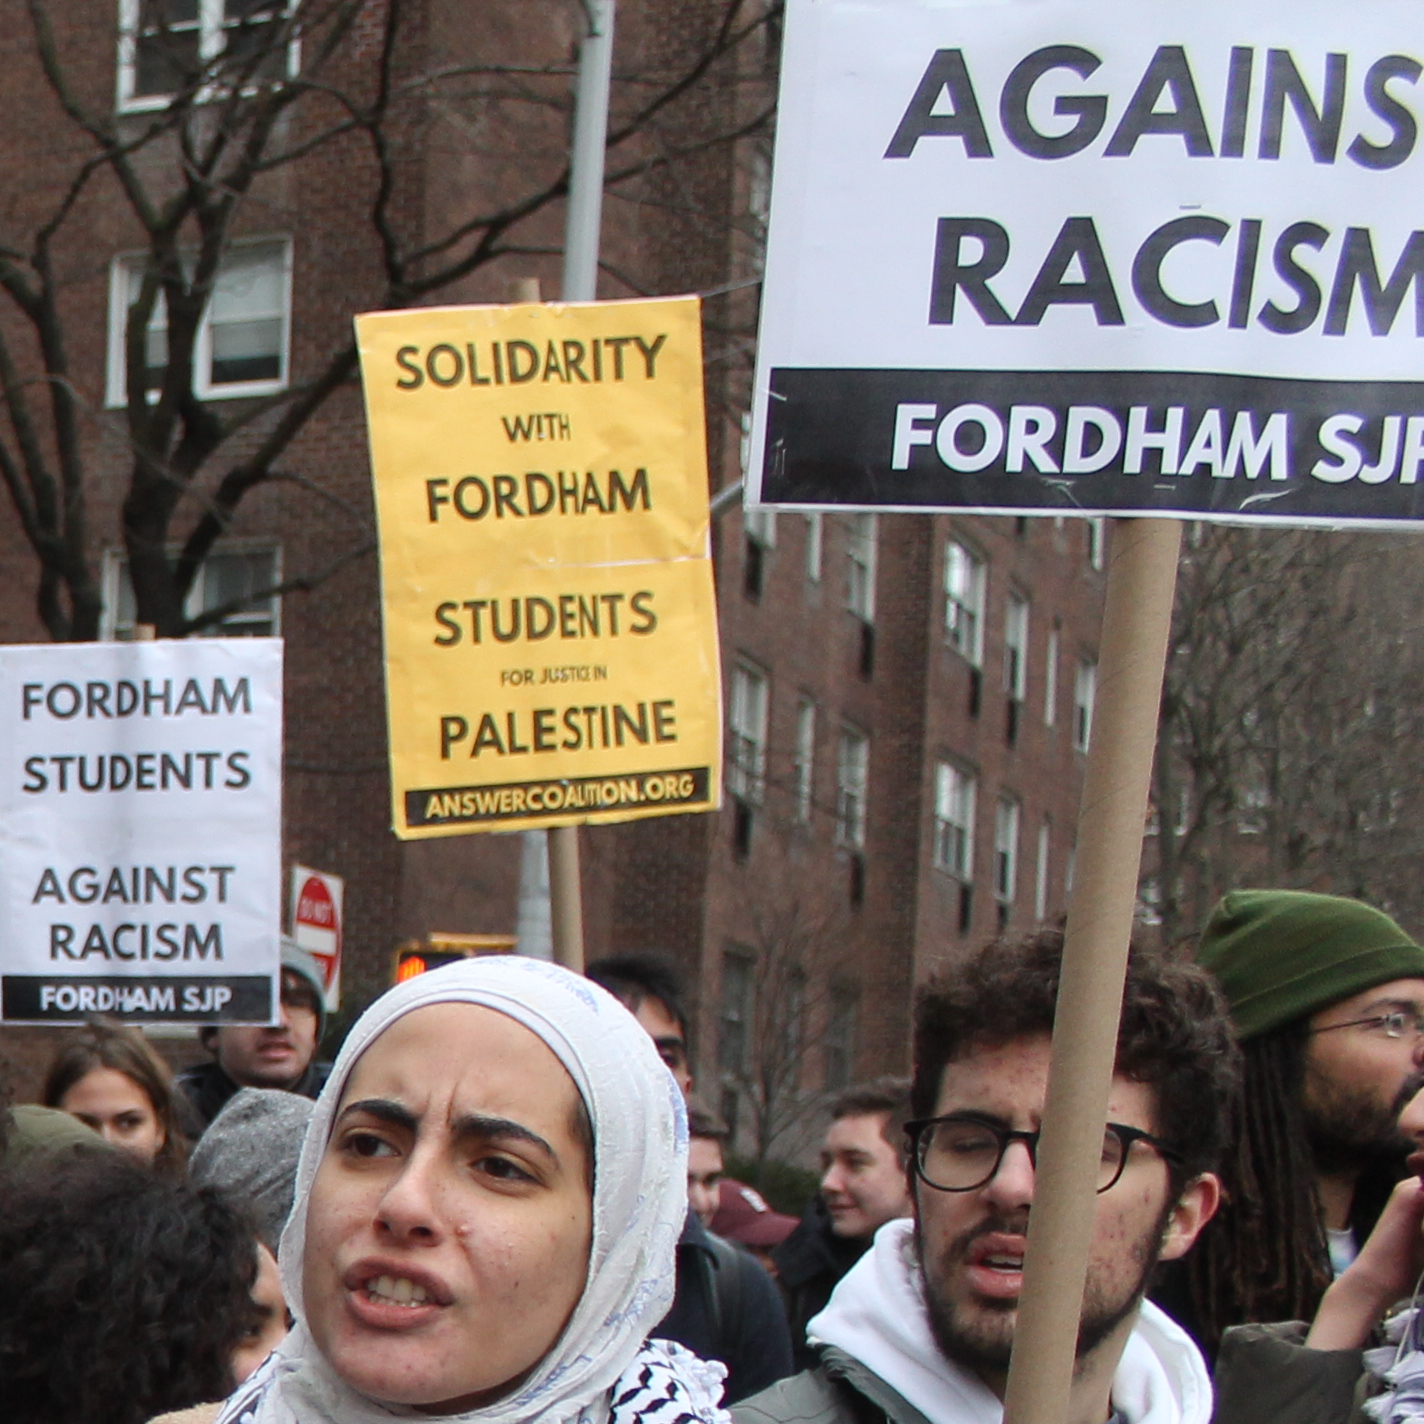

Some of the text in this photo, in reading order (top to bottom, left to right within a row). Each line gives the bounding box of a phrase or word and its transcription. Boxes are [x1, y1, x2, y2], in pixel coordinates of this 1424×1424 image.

[883, 44, 1424, 171] AGAINS
[928, 215, 1424, 338] RACISM
[395, 334, 667, 389] SOLIDARITY
[502, 412, 572, 443] WITH
[891, 402, 1288, 481] FORDHAM
[425, 468, 652, 523] FORDHAM
[433, 591, 659, 648] STUDENTS
[21, 676, 253, 720] FORDHAM
[500, 665, 608, 687] FOR JUSTICE IN
[439, 699, 679, 761] PALESTINE
[22, 750, 252, 793] STUDENTS
[424, 771, 695, 820] ANSWERCOALITION.ORG
[31, 865, 236, 905] AGAINST
[50, 923, 225, 962] RACISM
[40, 985, 233, 1013] FORDHAM SJP
